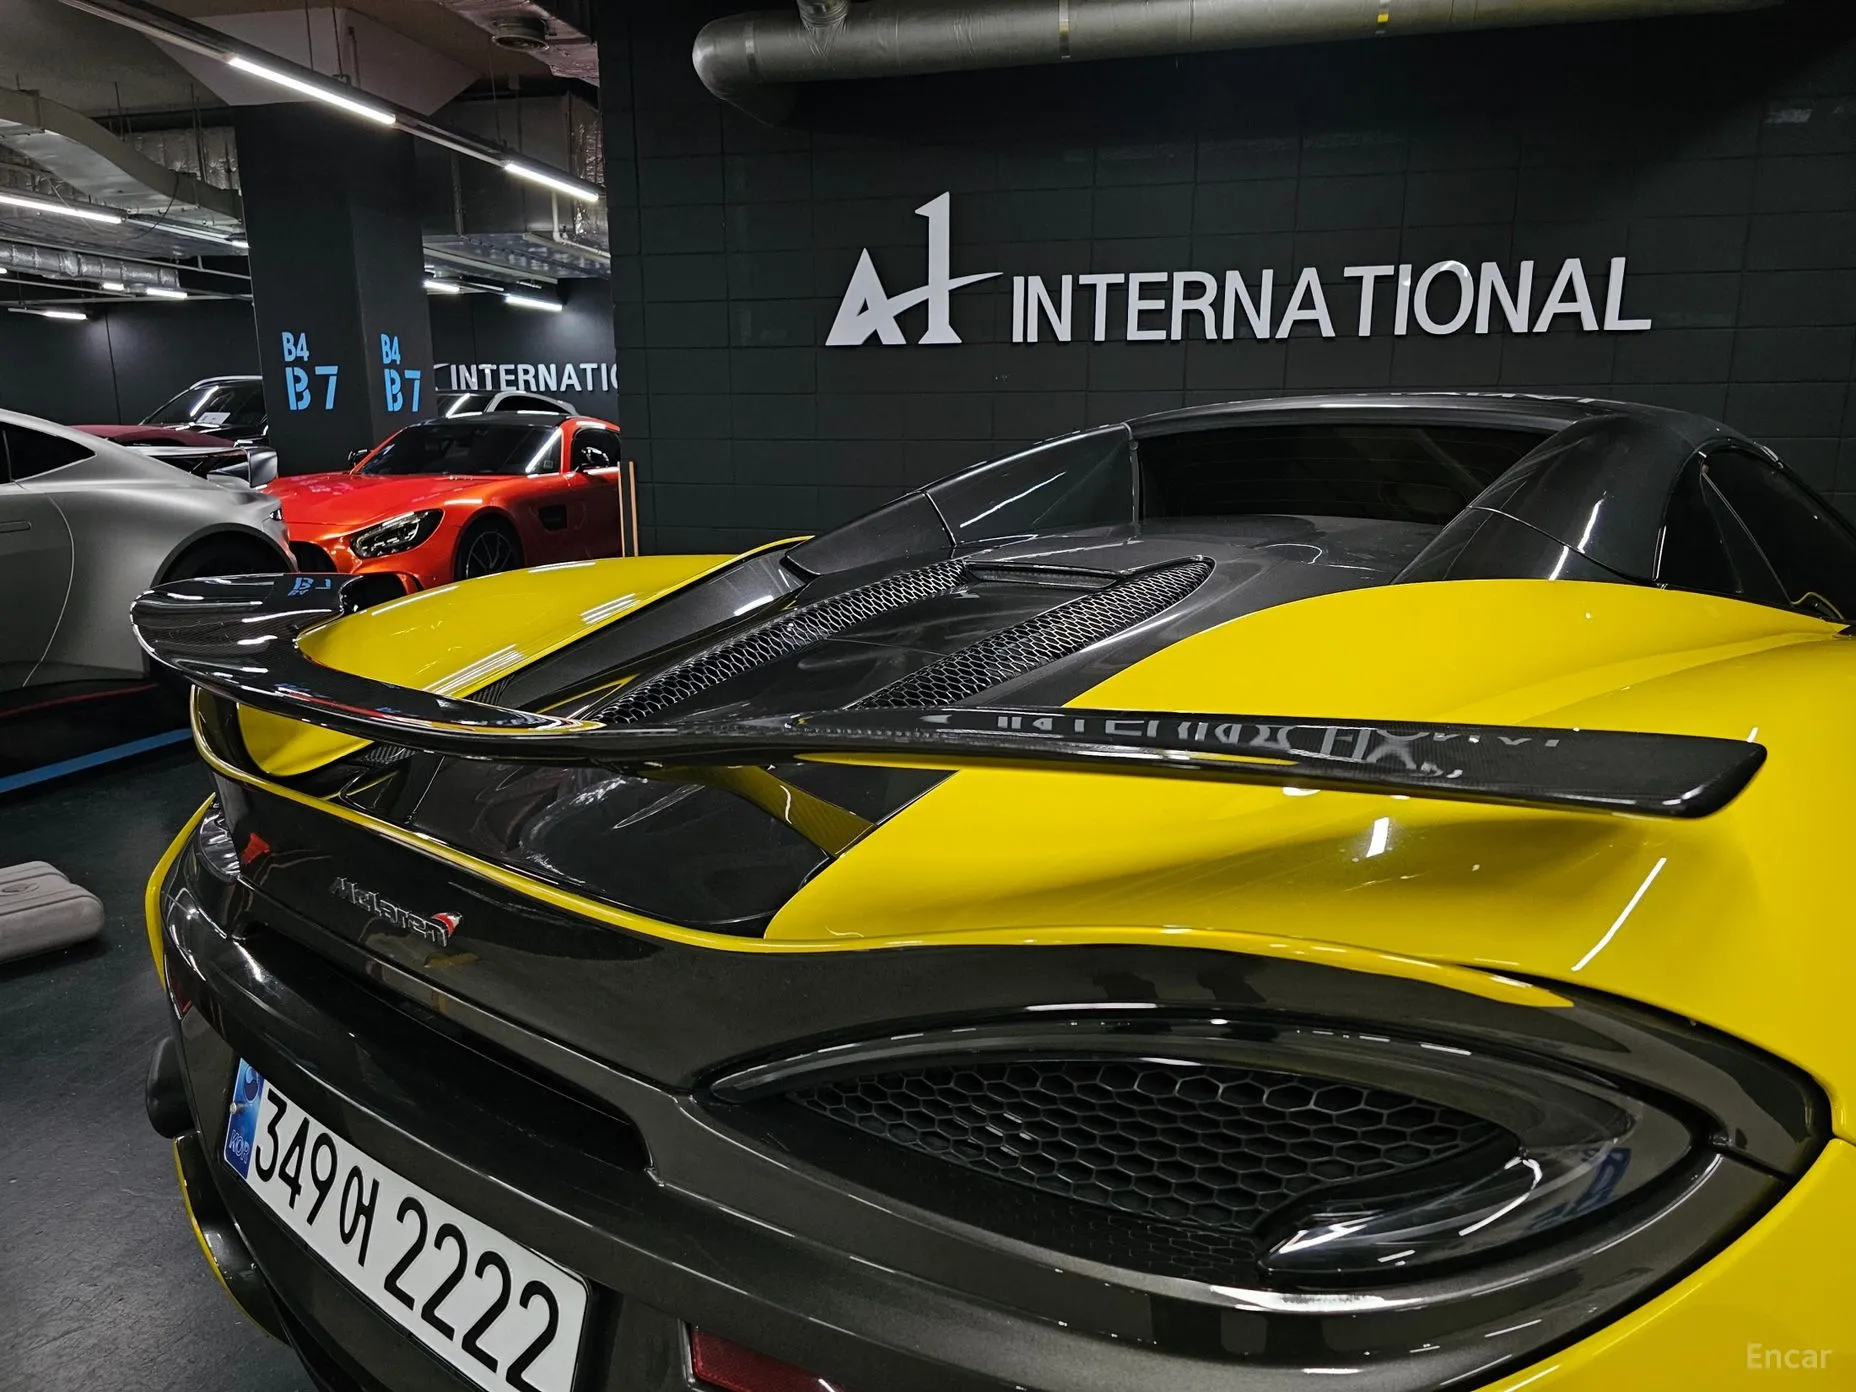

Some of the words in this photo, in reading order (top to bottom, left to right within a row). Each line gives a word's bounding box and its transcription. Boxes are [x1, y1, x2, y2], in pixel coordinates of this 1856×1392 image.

[1011, 257, 1653, 344] INTERNATIONAL
[282, 331, 309, 361] B4
[380, 333, 401, 364] B4
[285, 365, 338, 411] B7
[384, 369, 421, 412] B7
[228, 1129, 250, 1165] KOR
[383, 1195, 560, 1392] 2222
